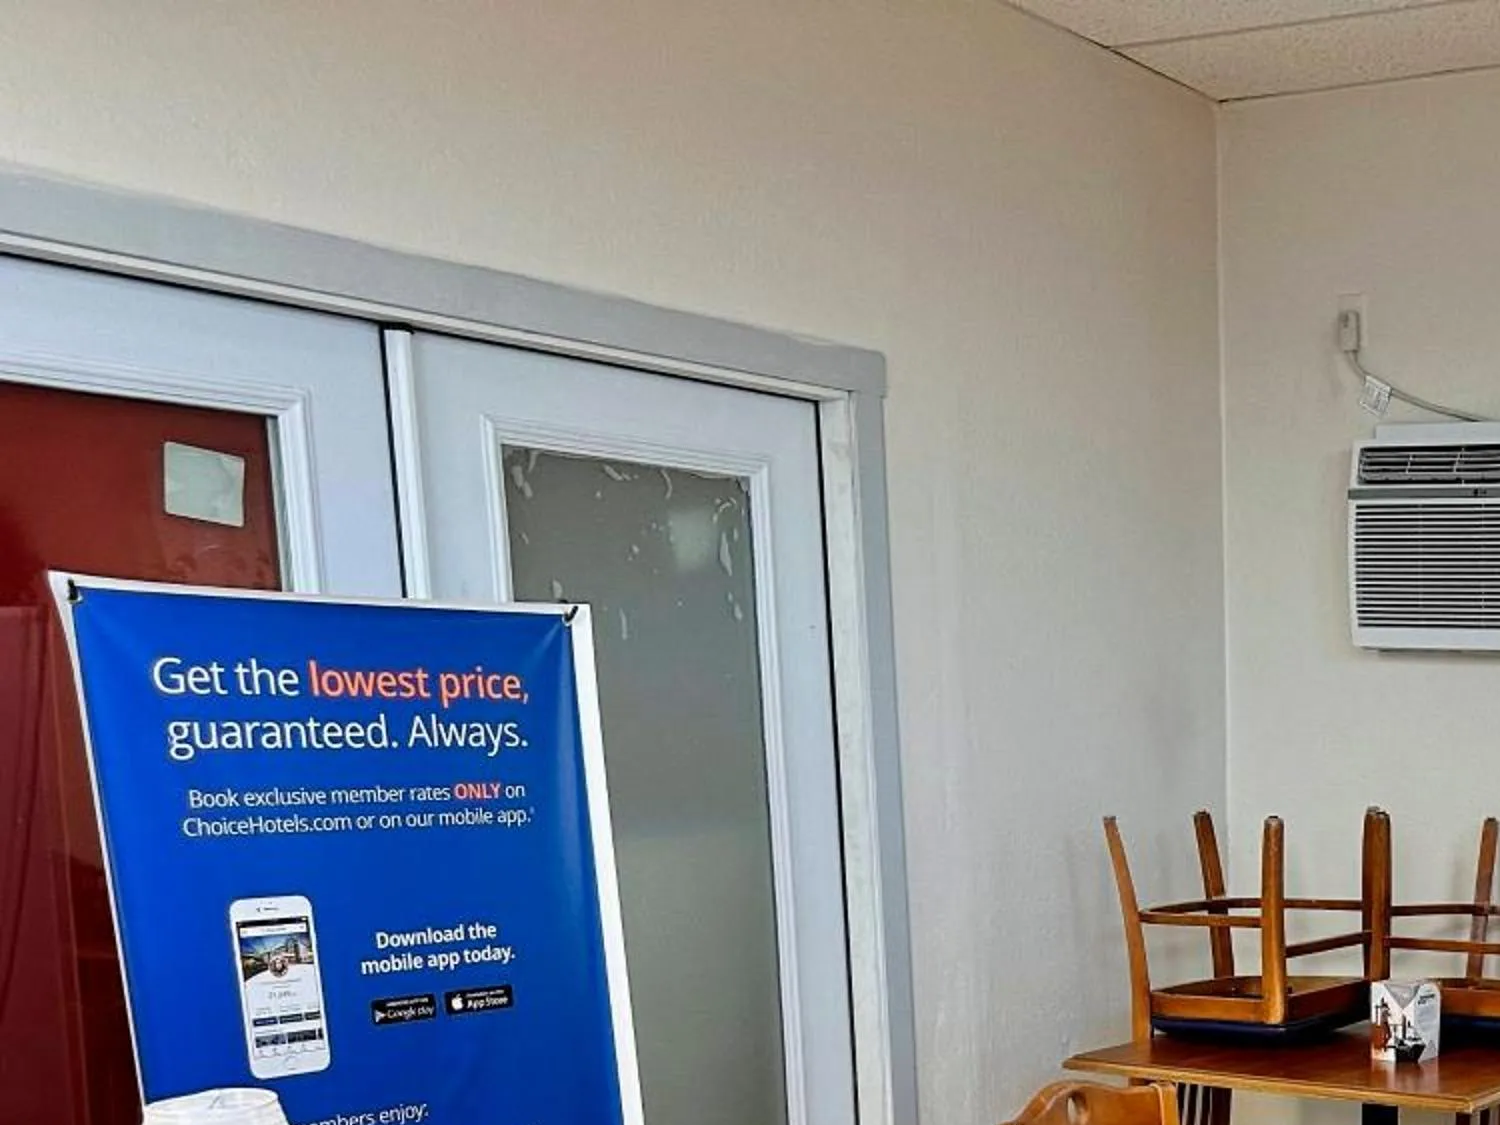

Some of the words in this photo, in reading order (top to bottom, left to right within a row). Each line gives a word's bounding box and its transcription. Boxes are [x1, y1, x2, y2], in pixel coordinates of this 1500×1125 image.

[153, 656, 229, 695] Get
[234, 657, 299, 696] the
[309, 659, 431, 698] lowest
[439, 665, 529, 708] price,
[167, 713, 399, 761] guaranteed.
[408, 713, 529, 757] Always.
[189, 788, 240, 809] Book
[244, 787, 327, 807] exclusive
[331, 785, 404, 804] member
[409, 785, 450, 801] rates
[454, 783, 500, 800] ONLY
[505, 785, 526, 799] on
[183, 813, 353, 837] ChoiceHotels.com
[357, 814, 375, 829] or
[379, 814, 402, 829] on
[406, 812, 435, 828] our
[439, 808, 493, 825] mobile
[376, 923, 464, 949] Download
[468, 921, 497, 940] the
[361, 952, 423, 975] mobile
[427, 951, 460, 971] app
[463, 944, 515, 964] today.
[379, 1103, 428, 1125] enjoy:
